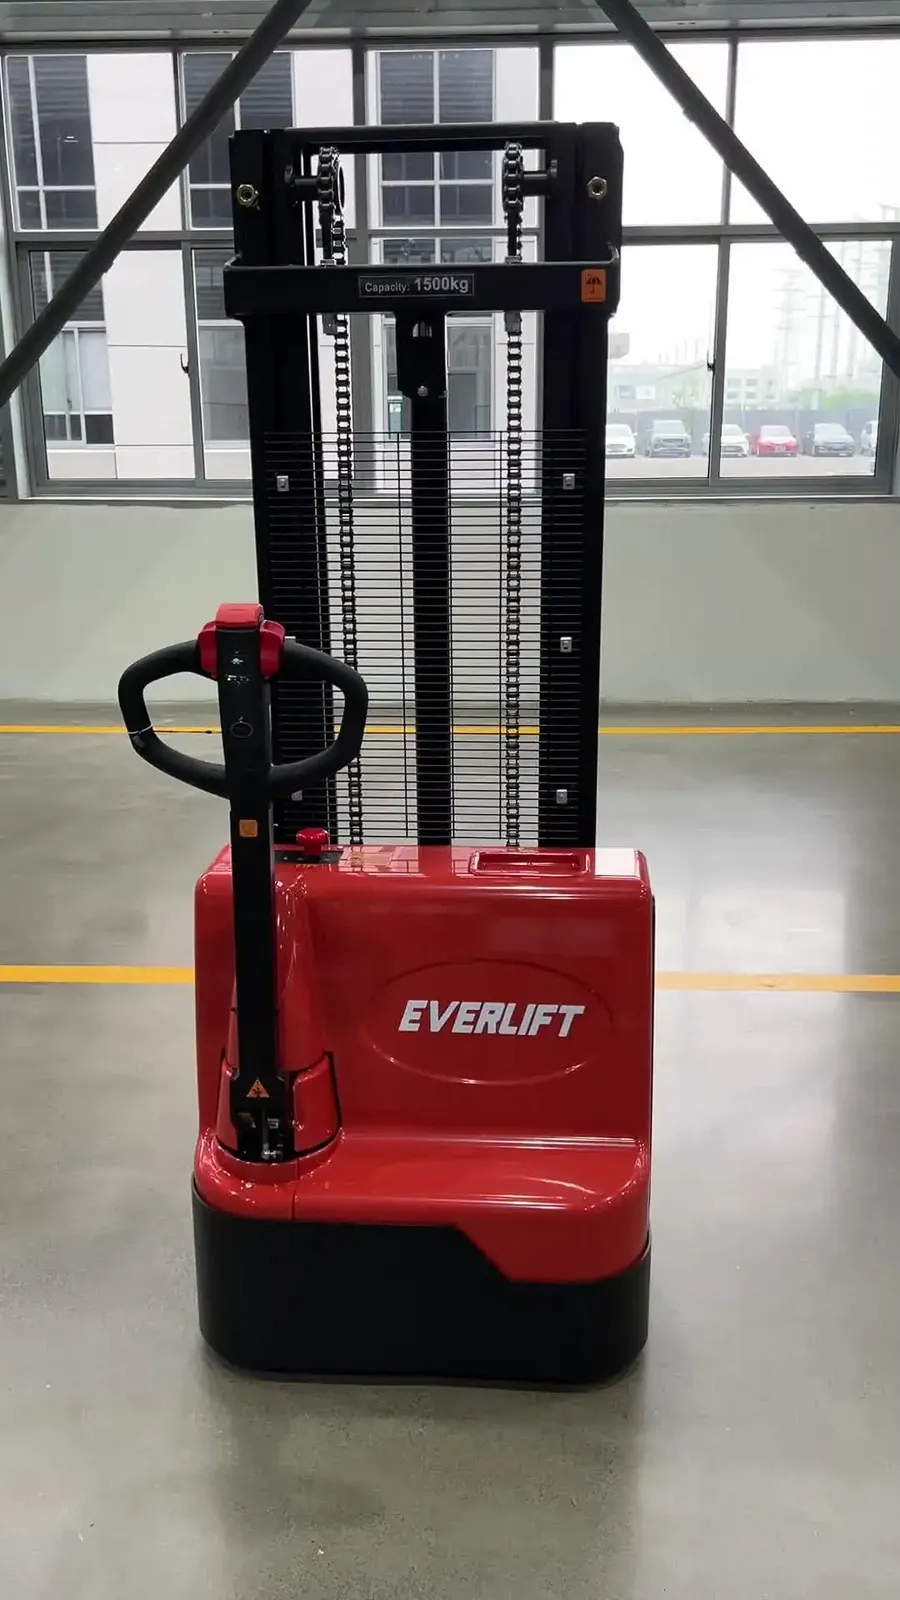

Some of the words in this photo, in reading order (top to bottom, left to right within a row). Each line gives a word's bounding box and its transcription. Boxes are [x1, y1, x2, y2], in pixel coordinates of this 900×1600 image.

[364, 282, 410, 294] Capacity:
[414, 276, 469, 294] 1500kg
[398, 1000, 585, 1037] EVERLIFT
